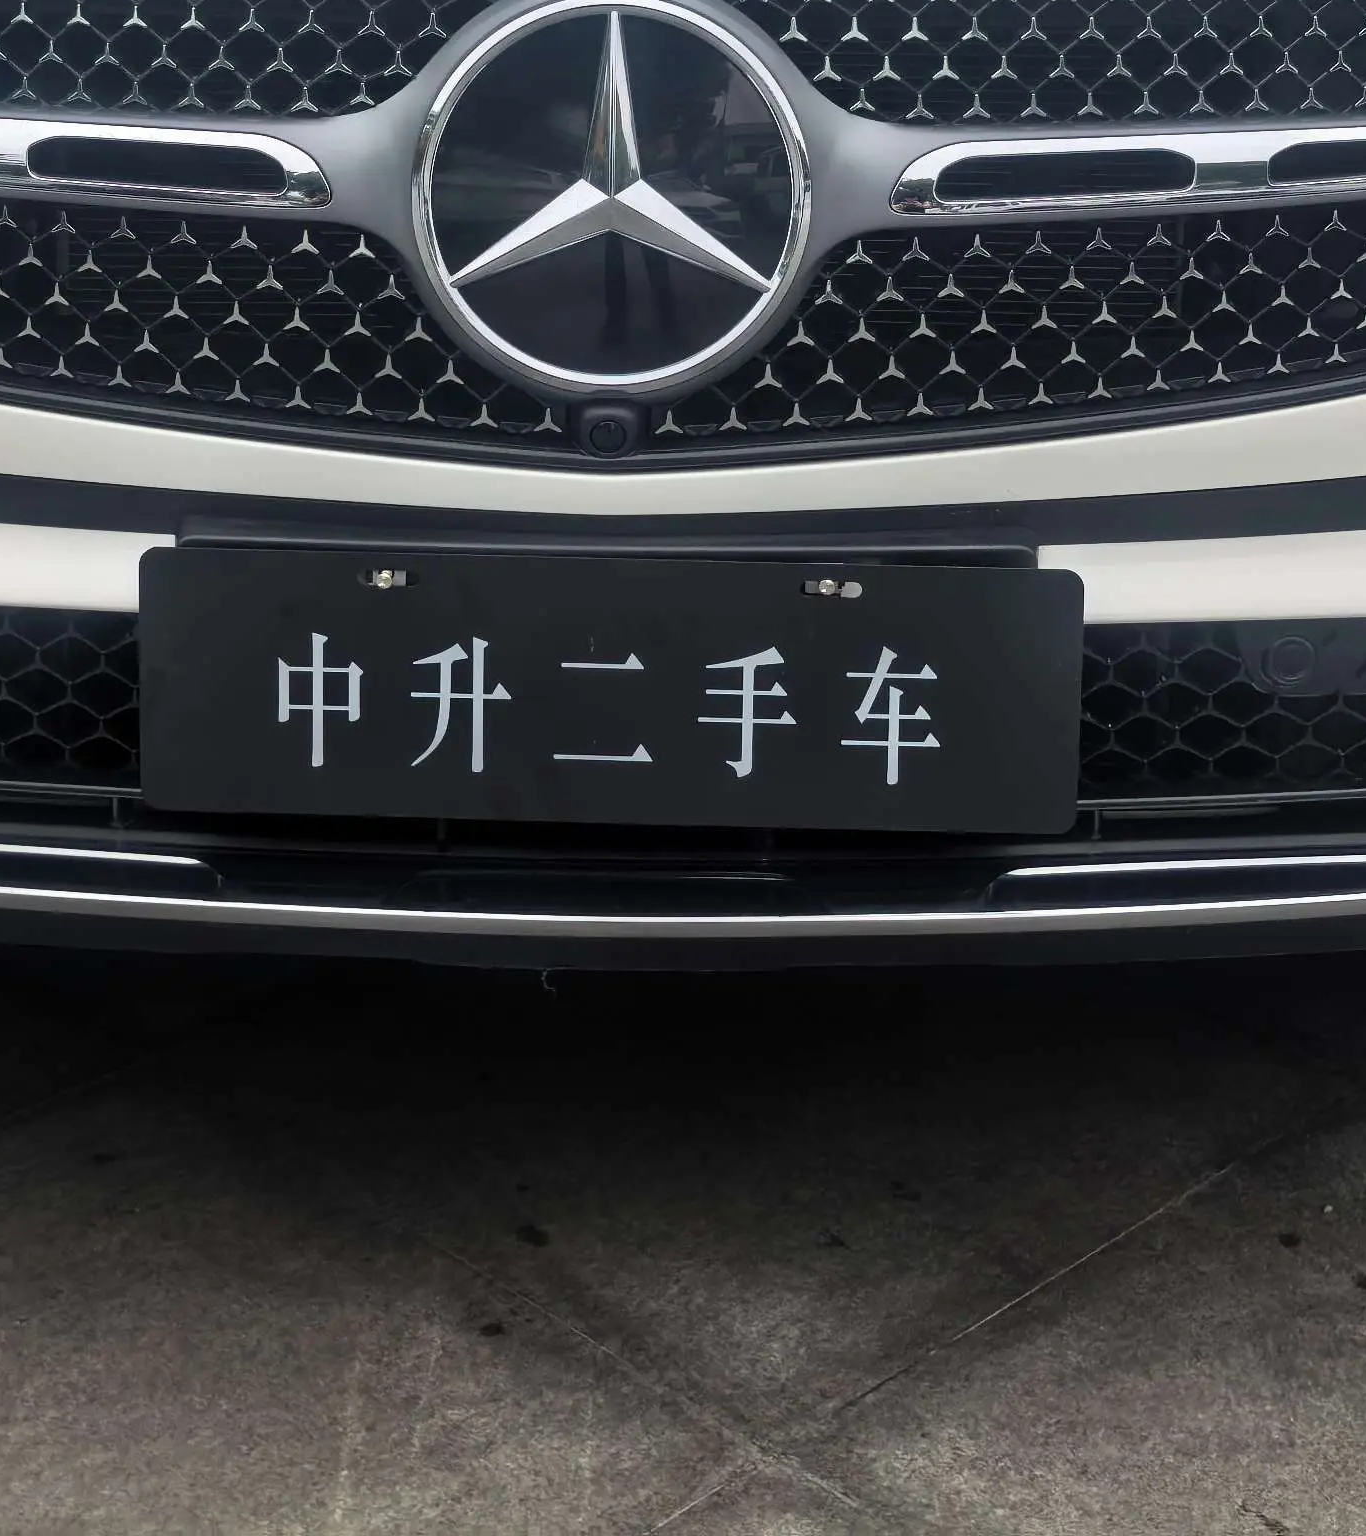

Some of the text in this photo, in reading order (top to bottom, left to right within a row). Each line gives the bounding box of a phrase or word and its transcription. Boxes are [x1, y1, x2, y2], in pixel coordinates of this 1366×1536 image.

[277, 631, 941, 786] 中升二手车
